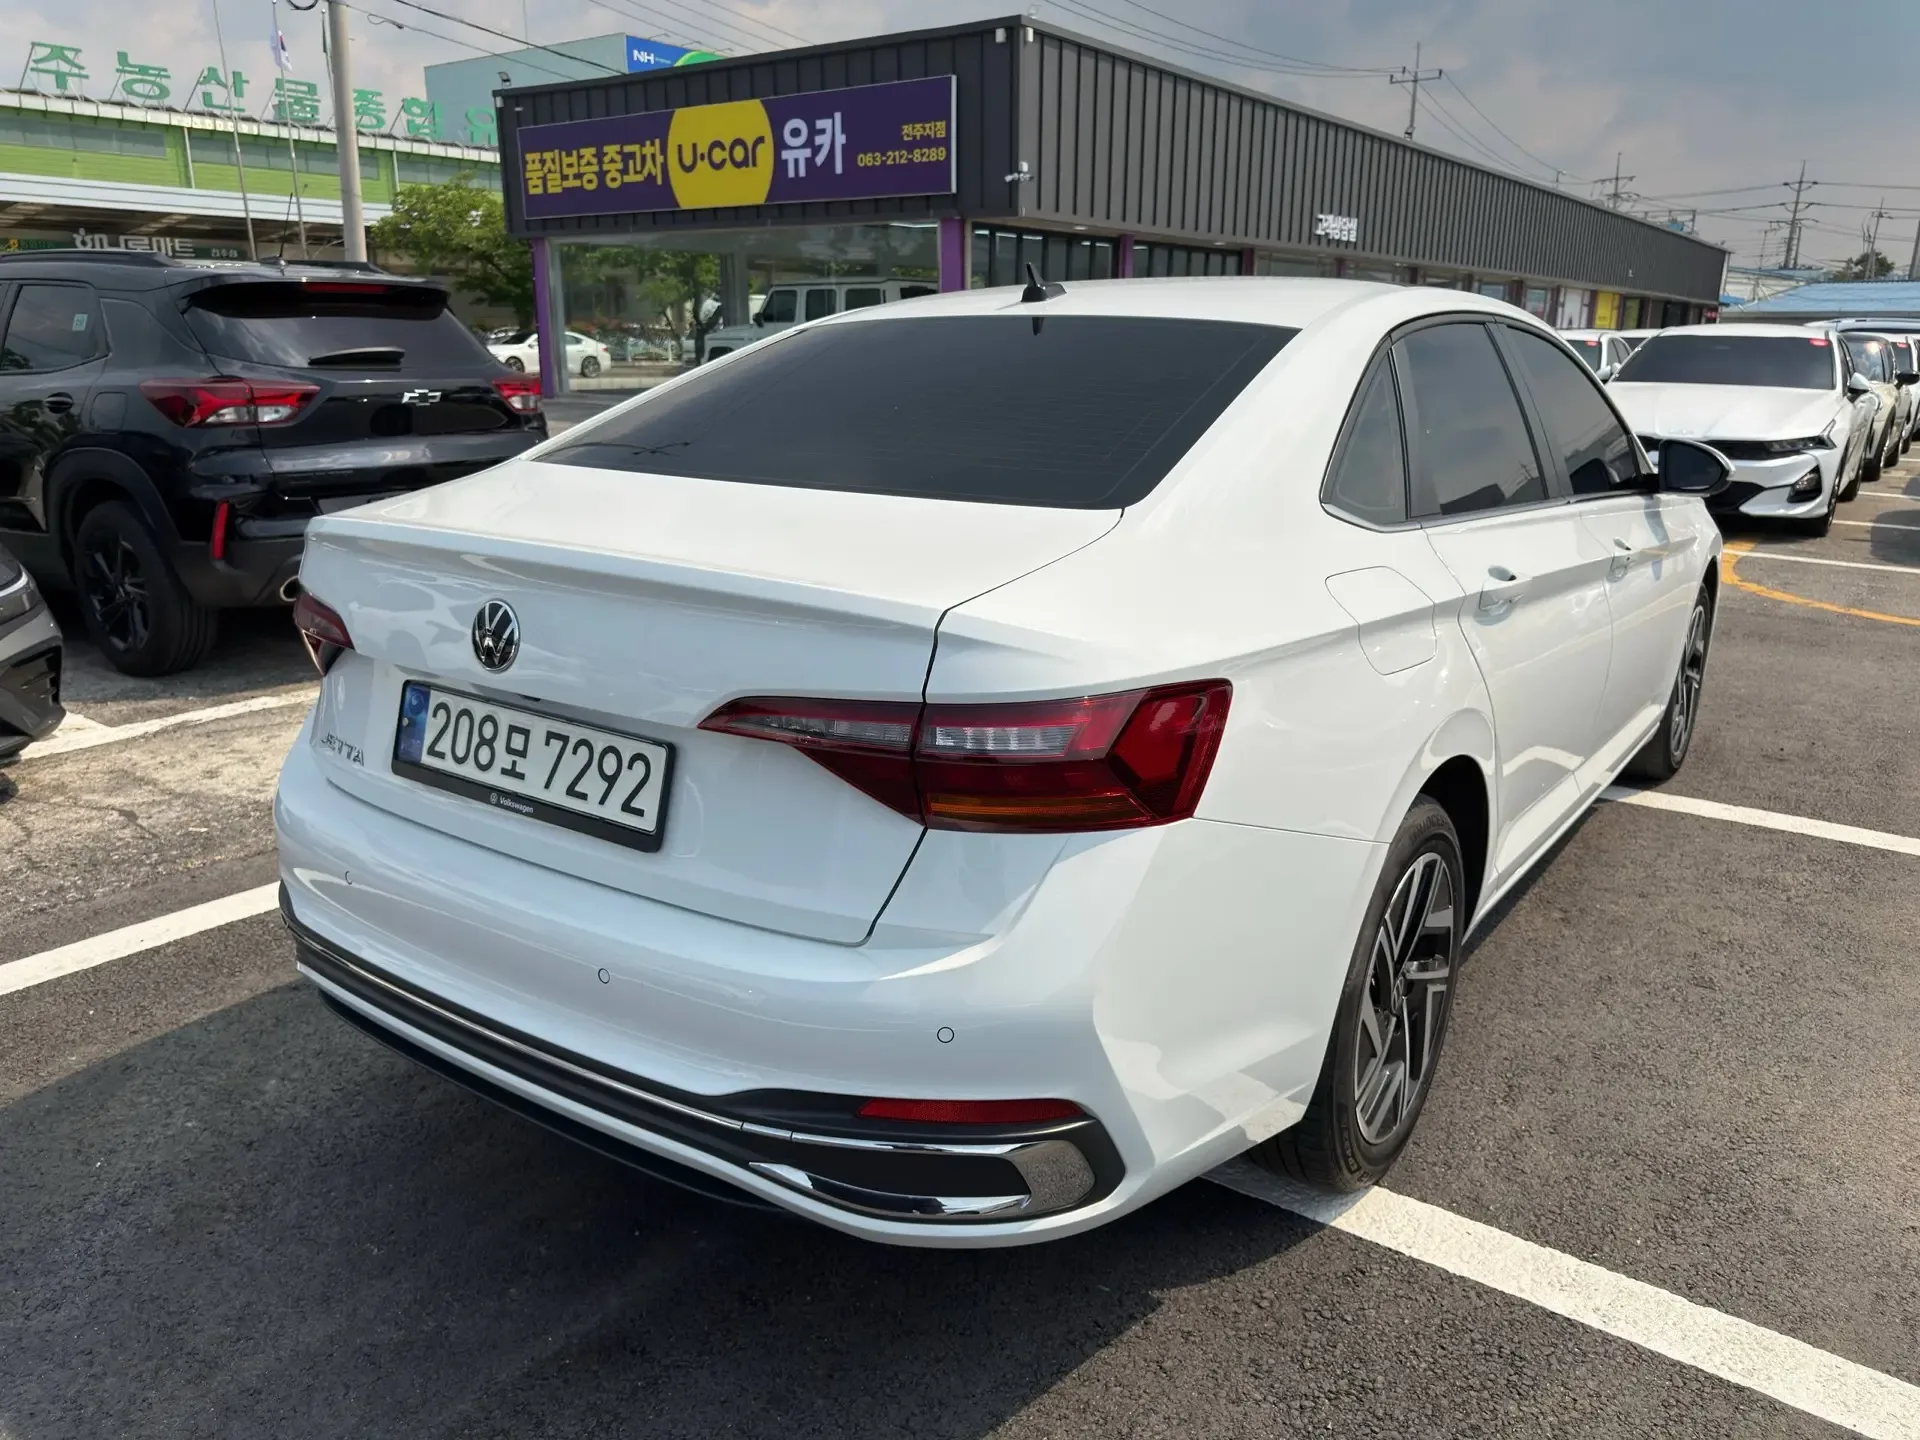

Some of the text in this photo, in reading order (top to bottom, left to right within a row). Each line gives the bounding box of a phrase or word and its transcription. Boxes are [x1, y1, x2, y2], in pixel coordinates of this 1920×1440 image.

[633, 49, 655, 65] NH
[781, 111, 847, 178] 유카
[902, 120, 946, 141] 전주지점
[525, 138, 664, 195] 품질보증 중고차
[857, 147, 947, 167] 063-212-8289
[321, 732, 365, 767] JETTA
[543, 730, 652, 818] 7292
[500, 796, 534, 813] Volkswagen
